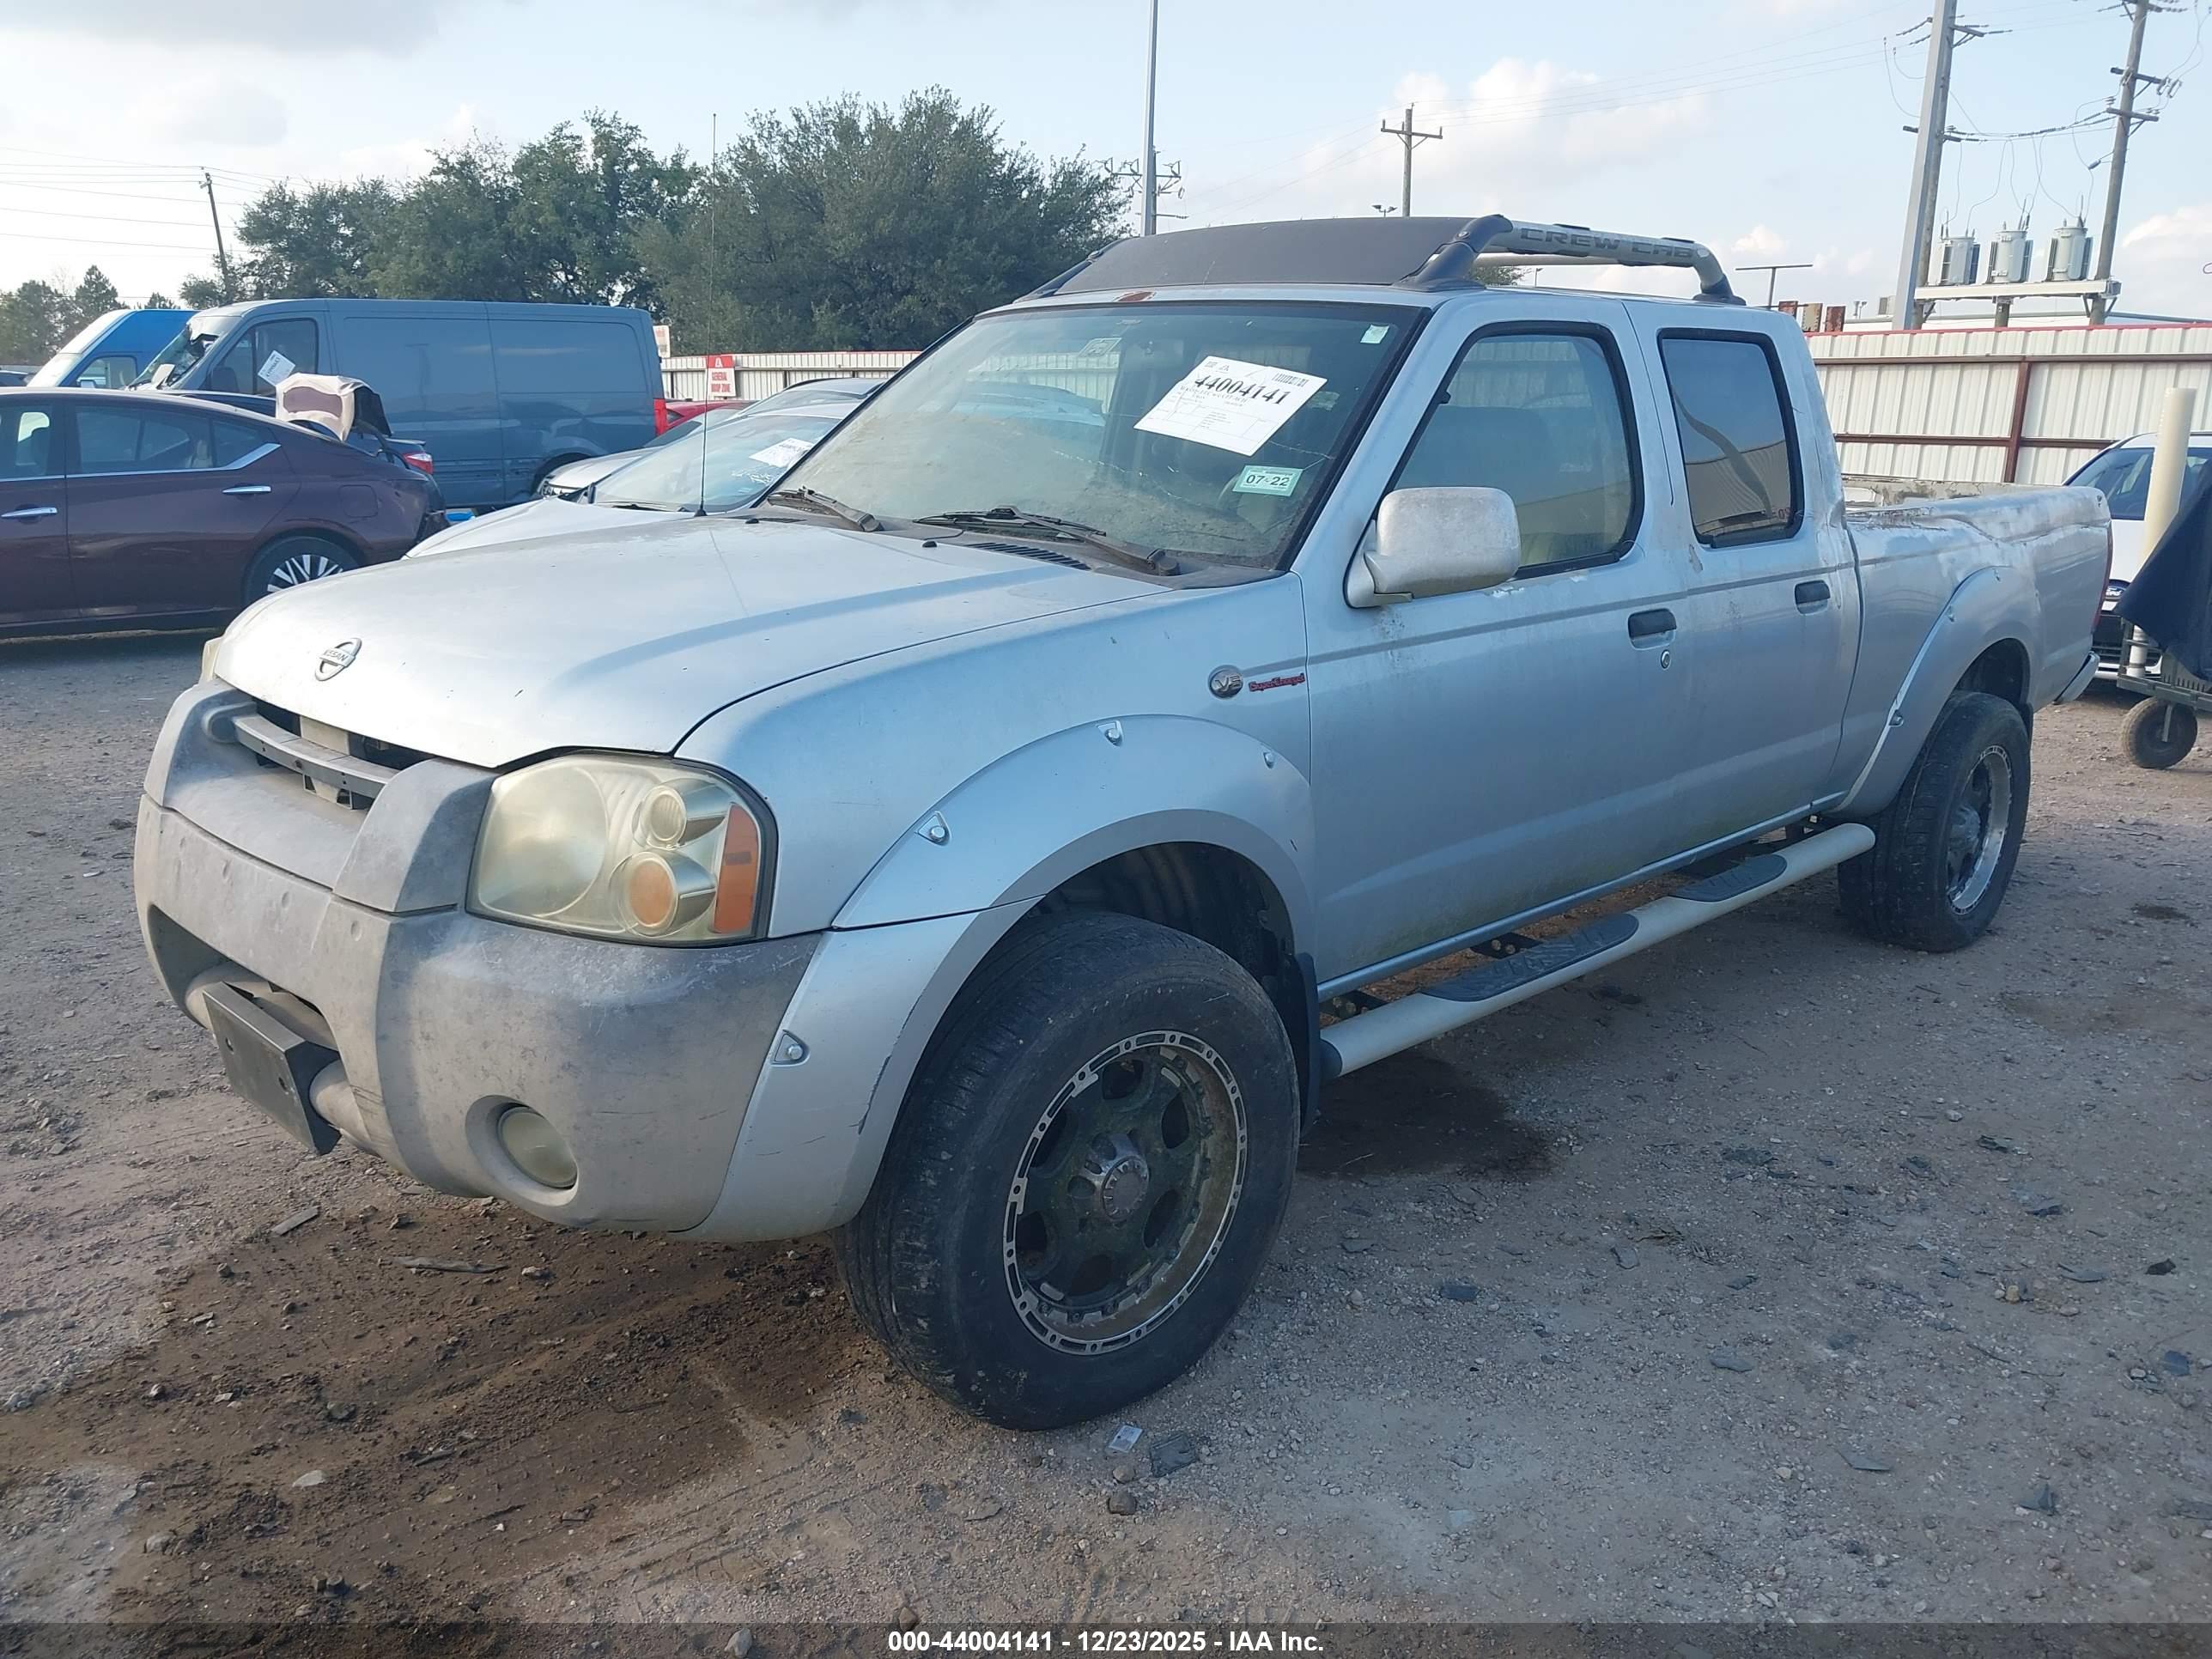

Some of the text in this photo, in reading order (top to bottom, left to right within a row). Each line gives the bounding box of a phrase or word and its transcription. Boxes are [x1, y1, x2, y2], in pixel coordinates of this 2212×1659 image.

[1520, 228, 1694, 258] CREW CAB
[1194, 374, 1291, 405] 44004141
